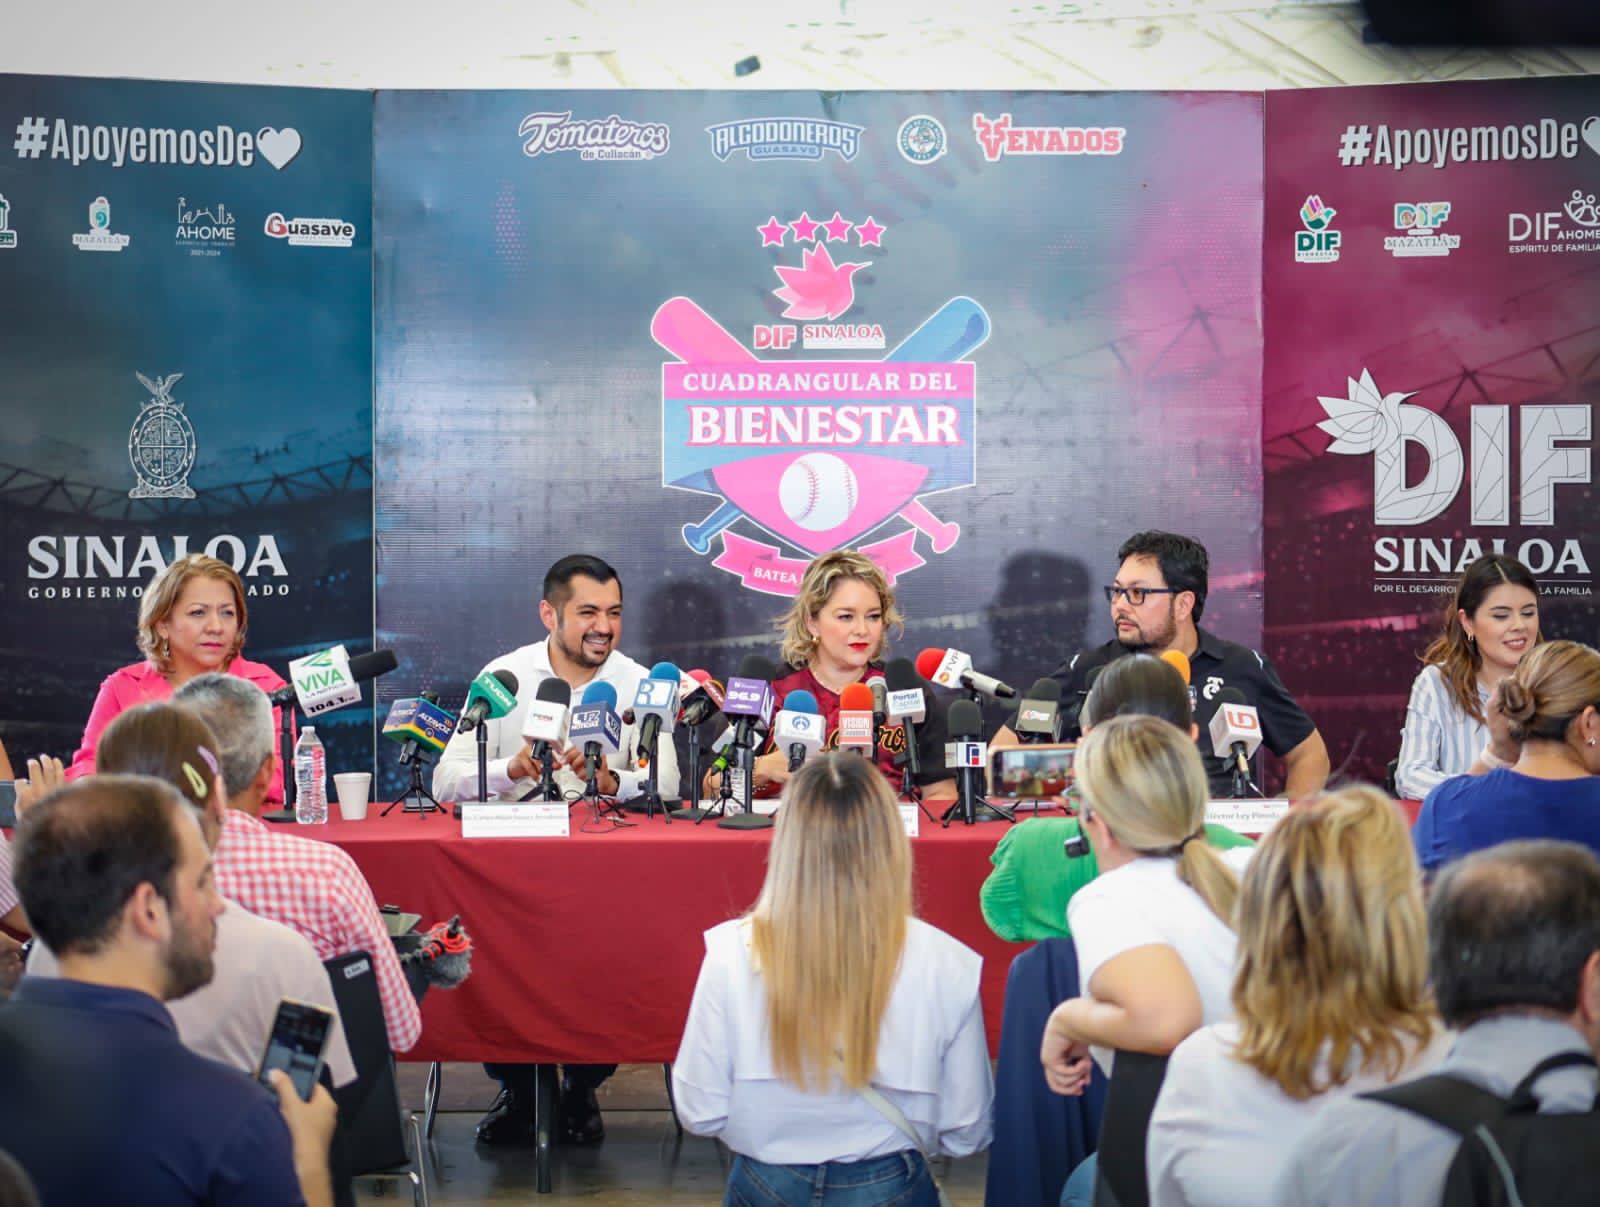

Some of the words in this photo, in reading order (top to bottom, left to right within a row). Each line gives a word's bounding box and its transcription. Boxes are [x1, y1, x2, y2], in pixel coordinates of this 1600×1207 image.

[14, 116, 254, 167] #ApoyemosDe
[520, 112, 669, 155] Tomateros
[714, 120, 857, 155] ALGODONEROS
[974, 113, 1122, 161] VENADOS
[1338, 118, 1579, 170] #ApoyemosDe
[582, 149, 595, 160] de
[754, 144, 818, 153] GUASAVE
[267, 214, 353, 237] Guasave
[1395, 203, 1451, 229] DIF
[1508, 212, 1562, 241] DIF
[1557, 230, 1600, 240] AHOME
[175, 226, 235, 241] AHOME
[1297, 232, 1340, 251] DIF
[1386, 234, 1459, 249] MAZATLÁN
[1509, 243, 1549, 253] ESPÍRITU
[1551, 243, 1564, 252] DE
[753, 325, 796, 348] DIF
[804, 325, 883, 339] SINALOA
[682, 372, 900, 392] CUADRANGULAR
[909, 372, 958, 391] DEL
[688, 404, 960, 446] BIENESTAR
[1375, 404, 1592, 527] DIF
[754, 567, 798, 584] BATEA
[28, 585, 143, 599] GOBIERNO
[1374, 584, 1394, 594] POR
[1395, 584, 1408, 594] EL
[1554, 586, 1592, 596] FAMILIA
[297, 668, 345, 693] VIVA
[308, 697, 345, 714] 104.1
[892, 692, 918, 701] Portal
